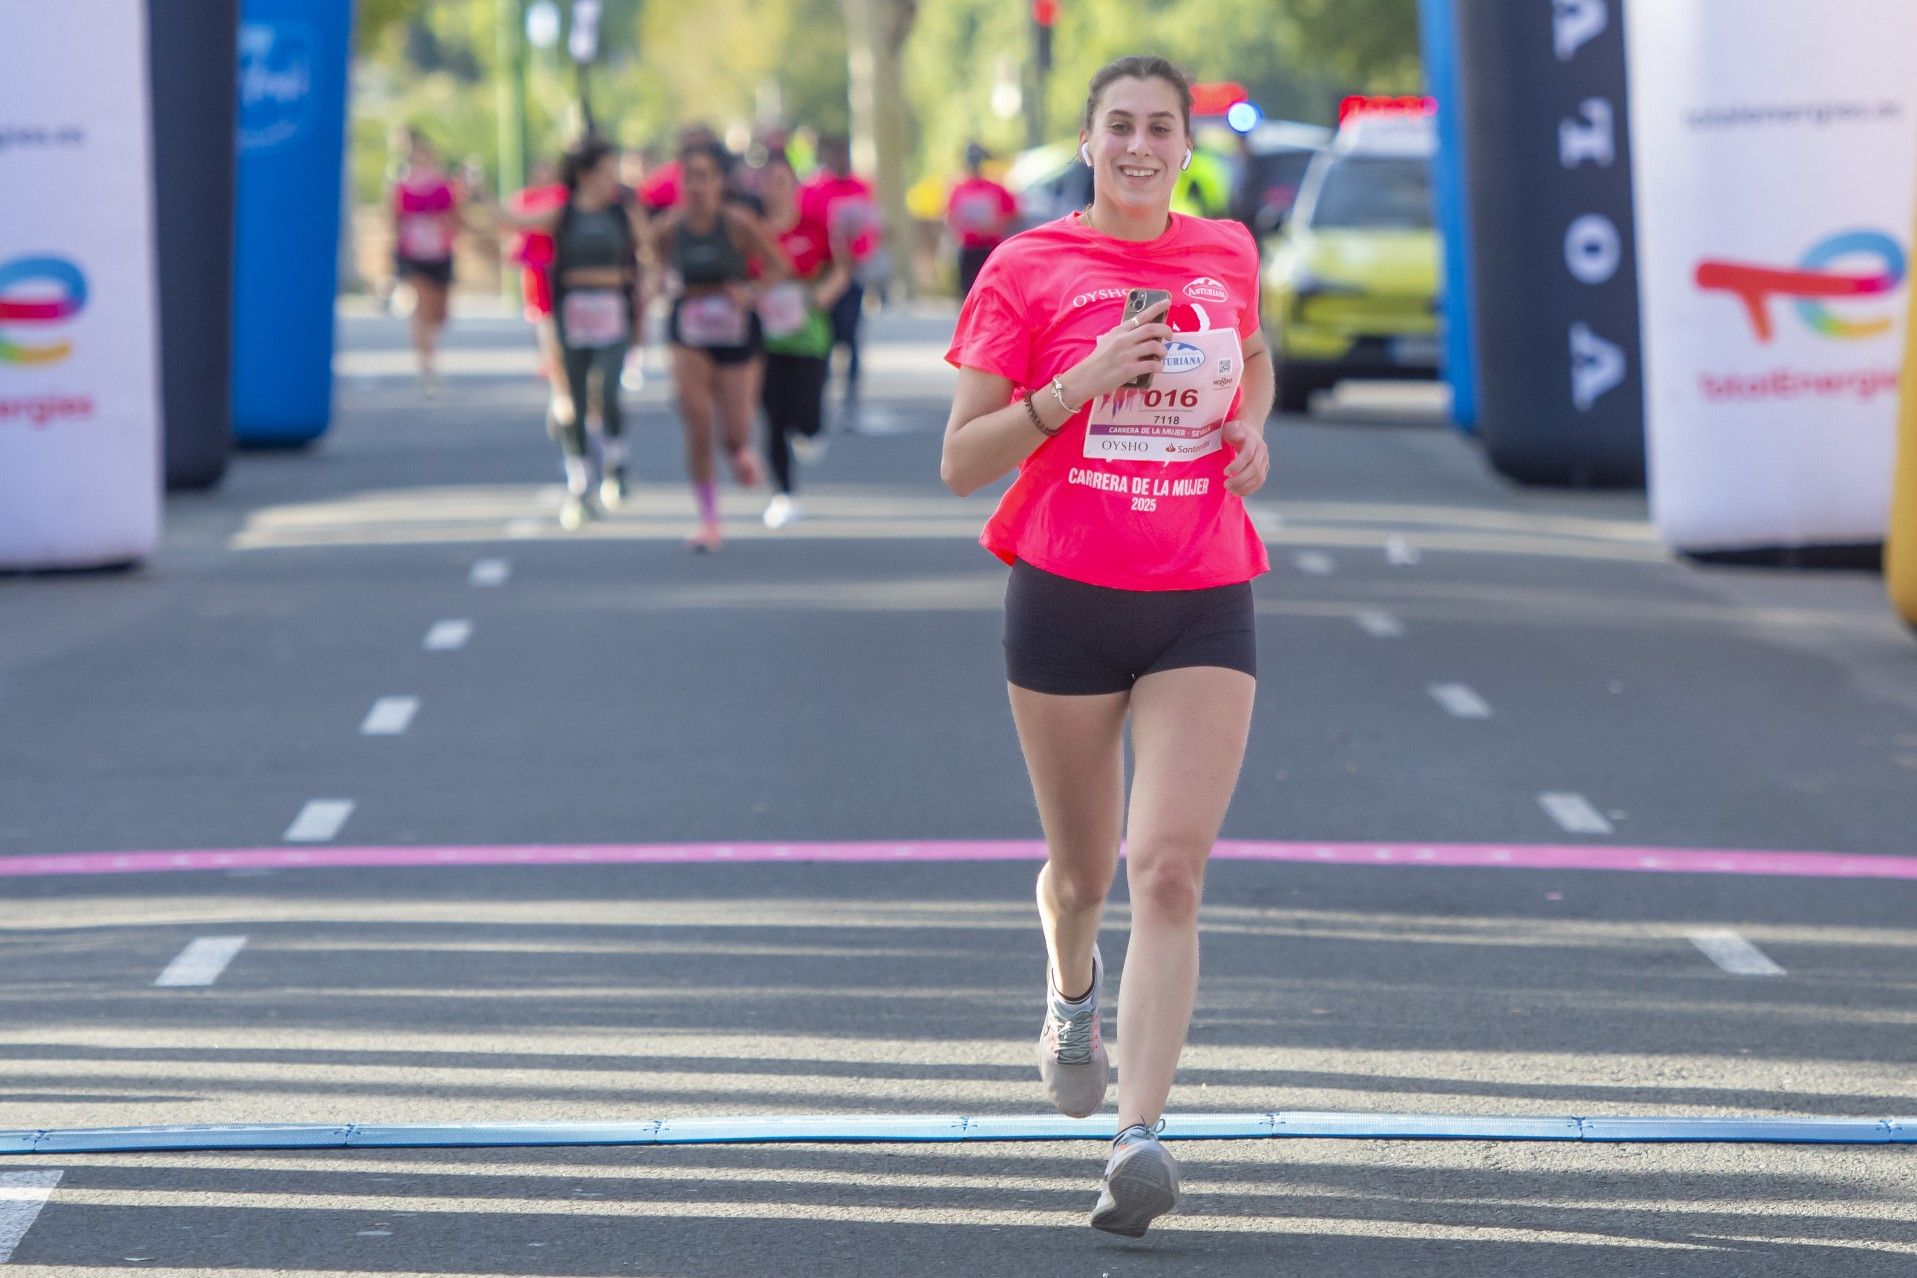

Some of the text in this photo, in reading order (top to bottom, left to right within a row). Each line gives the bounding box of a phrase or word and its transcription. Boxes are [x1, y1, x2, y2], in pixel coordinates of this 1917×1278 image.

[1699, 368, 1900, 402] TotalEnergie
[1144, 389, 1198, 407] 016
[1154, 415, 1180, 425] 7118
[1151, 427, 1162, 435] LA
[1162, 428, 1185, 436] MUJER
[1101, 440, 1149, 453] OYSHO
[1068, 467, 1210, 497] CARRERA DE LA MUJER
[1131, 497, 1157, 512] 2025
